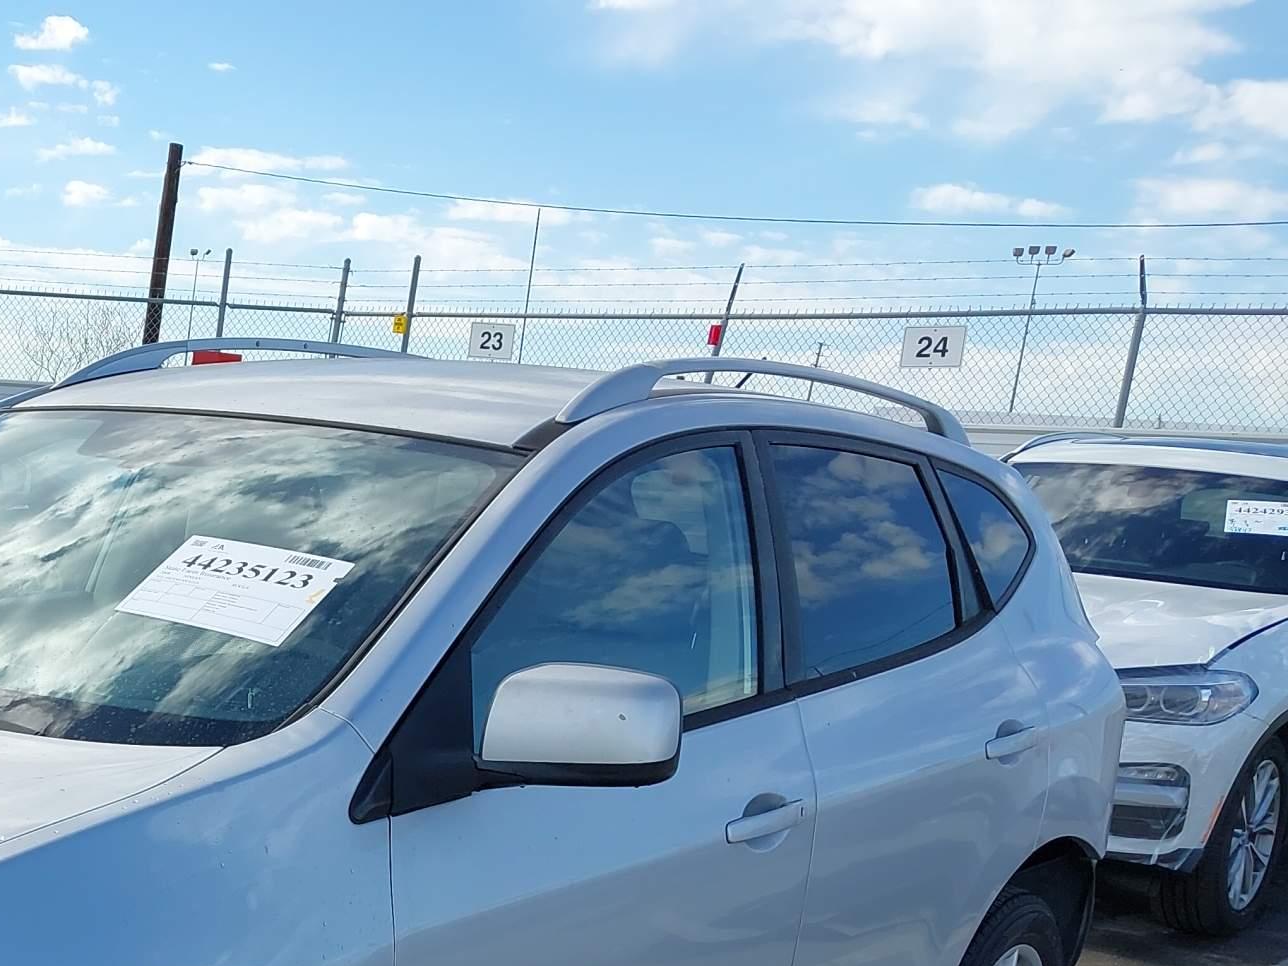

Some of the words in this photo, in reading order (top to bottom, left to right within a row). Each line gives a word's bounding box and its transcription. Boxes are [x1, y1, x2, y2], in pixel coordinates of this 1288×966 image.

[480, 331, 503, 351] 23
[915, 336, 949, 358] 24
[182, 554, 314, 589] 44235123
